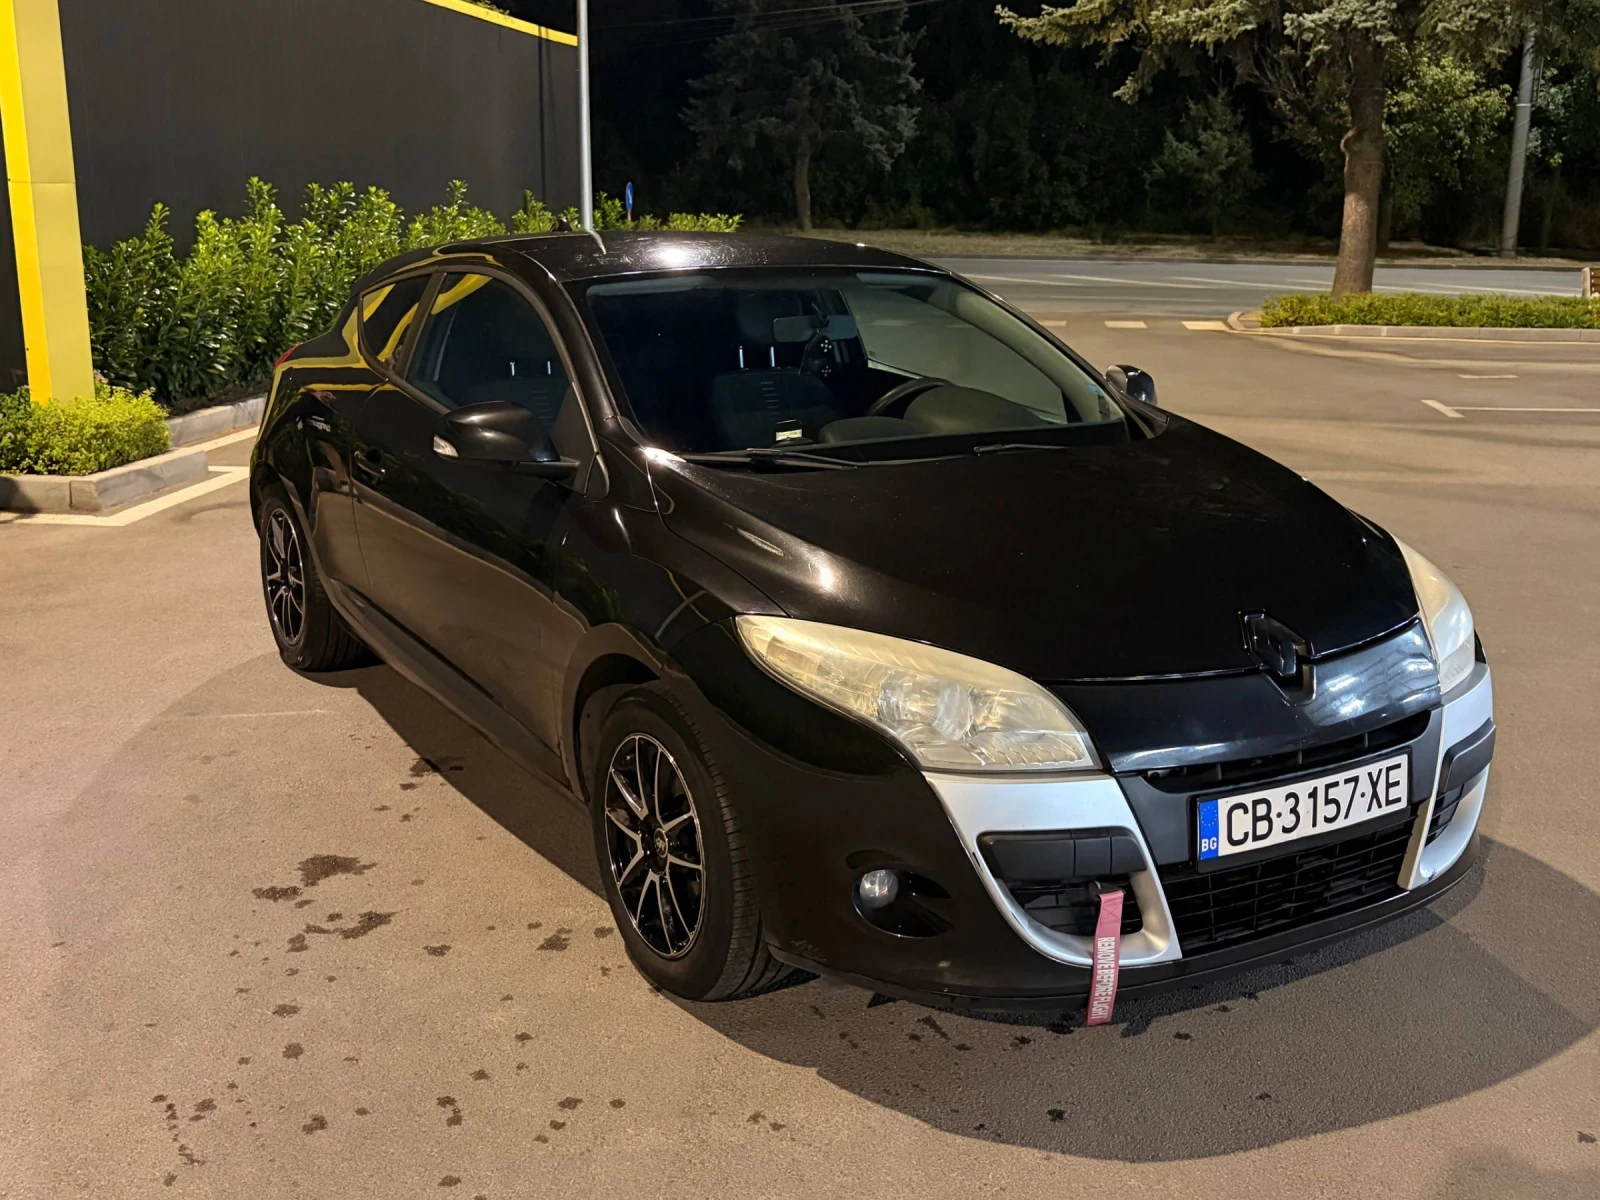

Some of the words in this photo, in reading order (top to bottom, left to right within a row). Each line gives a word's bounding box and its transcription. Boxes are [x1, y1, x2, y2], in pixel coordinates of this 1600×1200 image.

[1201, 837, 1217, 853] BG
[1097, 936, 1116, 969] REMOVE
[1094, 969, 1115, 997] BEFORE
[1091, 996, 1112, 1019] FLIGHT
